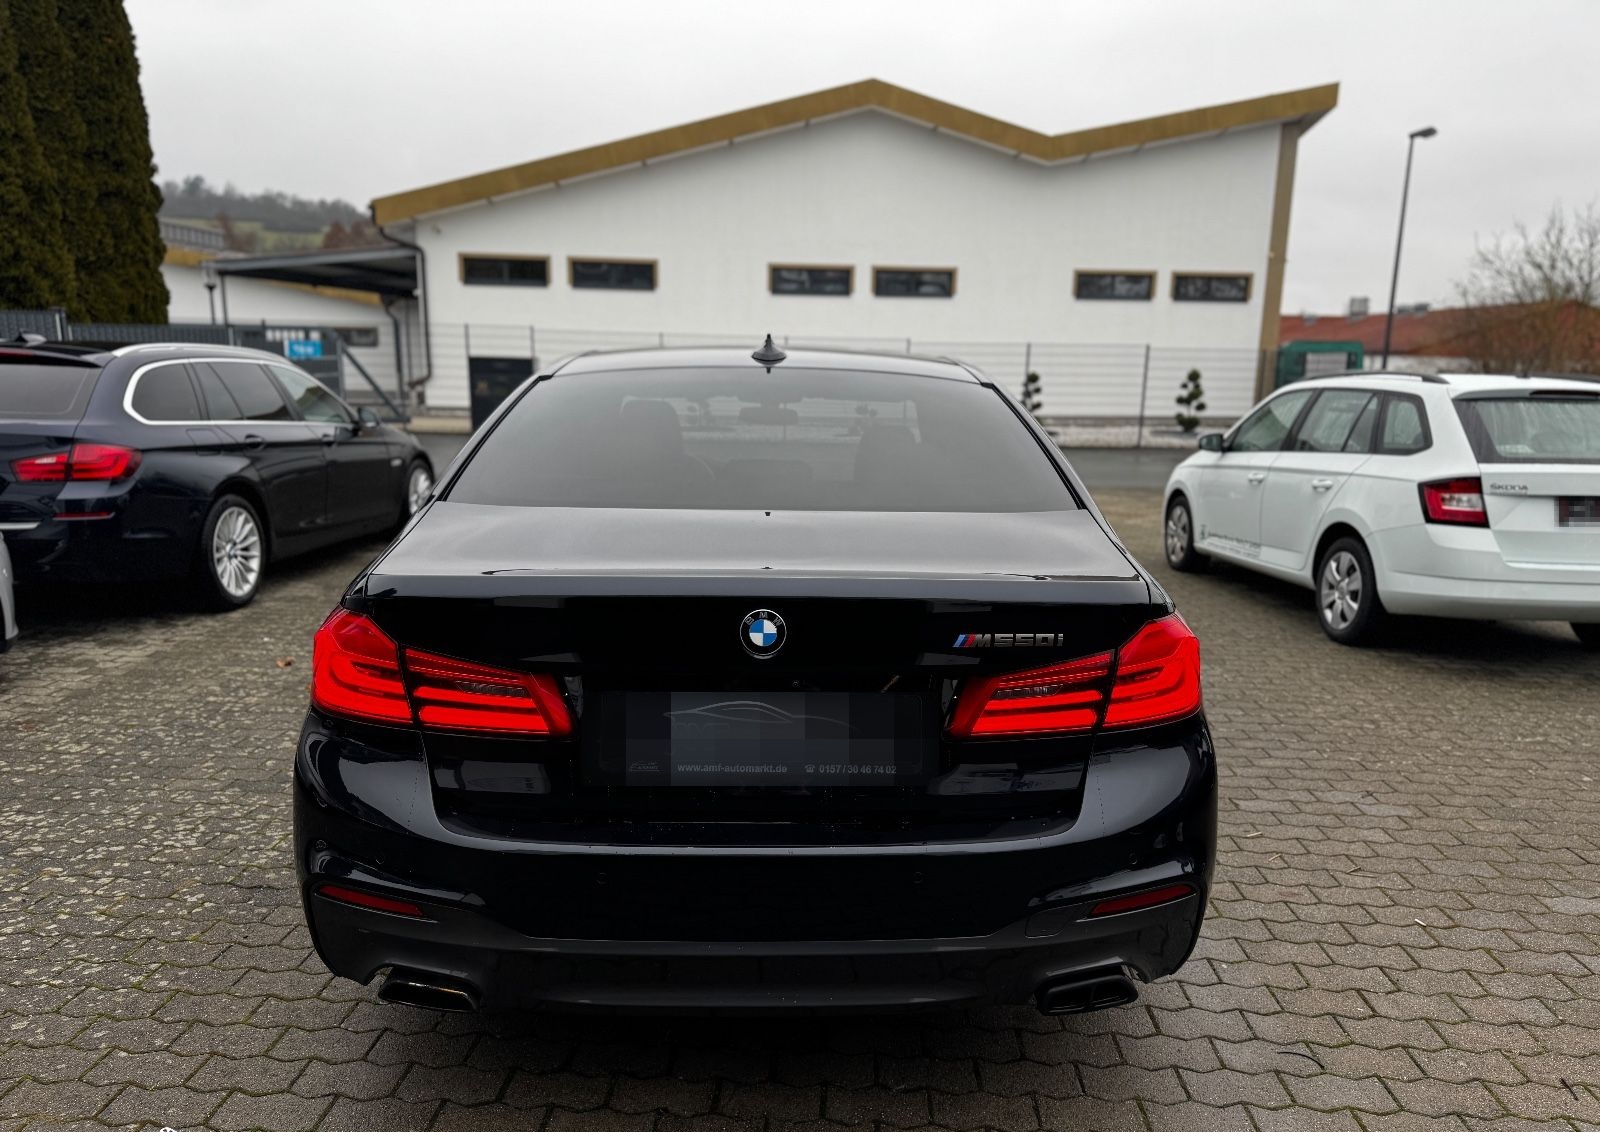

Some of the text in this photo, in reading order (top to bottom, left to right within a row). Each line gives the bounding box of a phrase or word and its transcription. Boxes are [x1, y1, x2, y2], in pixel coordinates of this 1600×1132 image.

[744, 611, 783, 626] BMW
[954, 633, 1064, 648] M550i
[676, 763, 788, 773] www.amf-automarkt.de
[819, 764, 842, 774] 0157
[860, 765, 872, 774] 46
[873, 766, 884, 774] 74
[885, 766, 897, 774] 02
